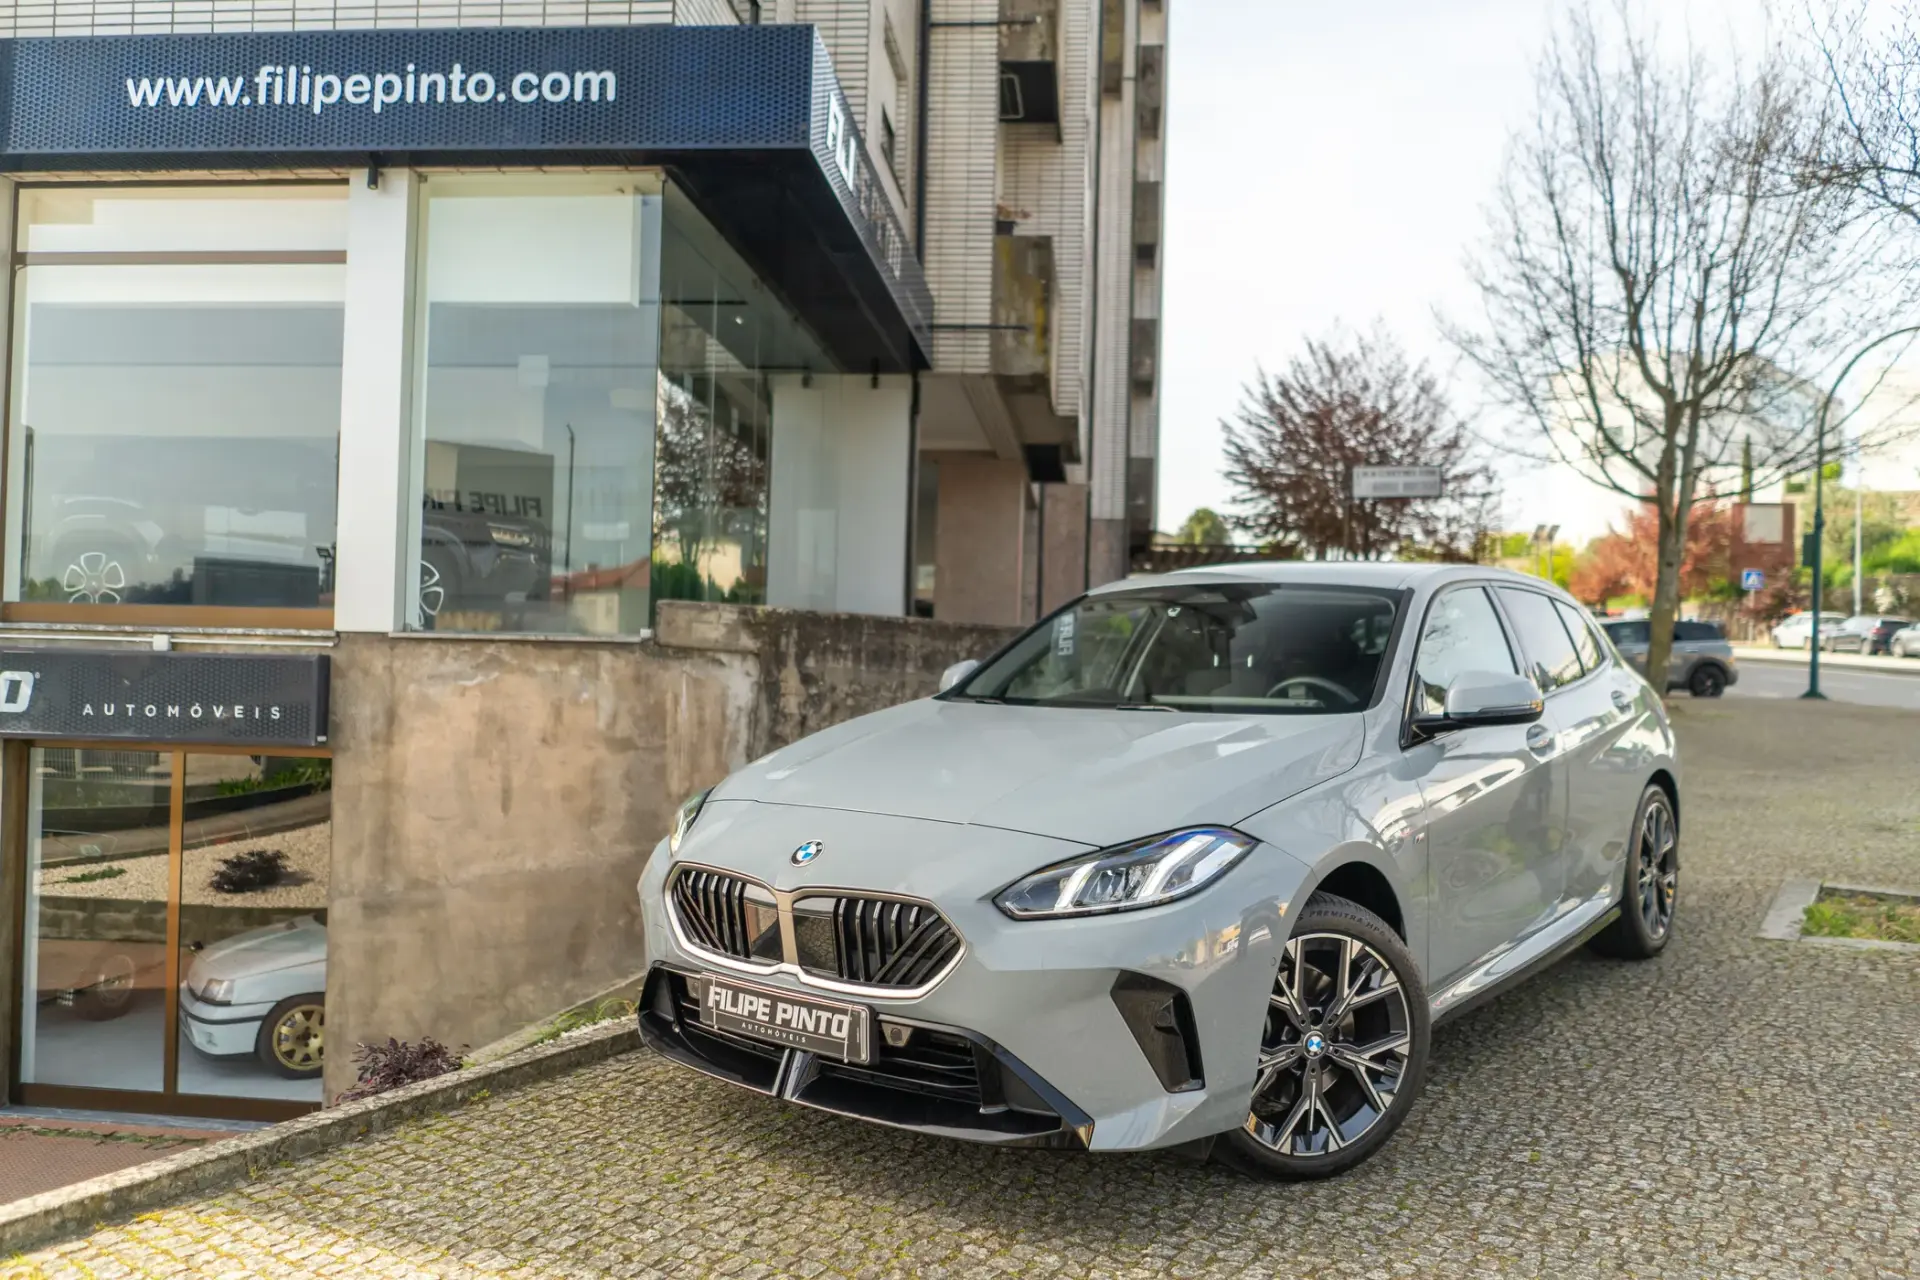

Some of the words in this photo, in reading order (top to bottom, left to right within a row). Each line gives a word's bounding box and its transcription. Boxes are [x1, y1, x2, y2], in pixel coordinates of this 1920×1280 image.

[126, 63, 617, 114] www.filipepinto.com
[82, 703, 281, 719] AUTOMÓVEIS
[707, 986, 771, 1022] FILIPE
[775, 1001, 852, 1039] PINTO
[741, 1022, 806, 1044] AUTOMÓVEIS
